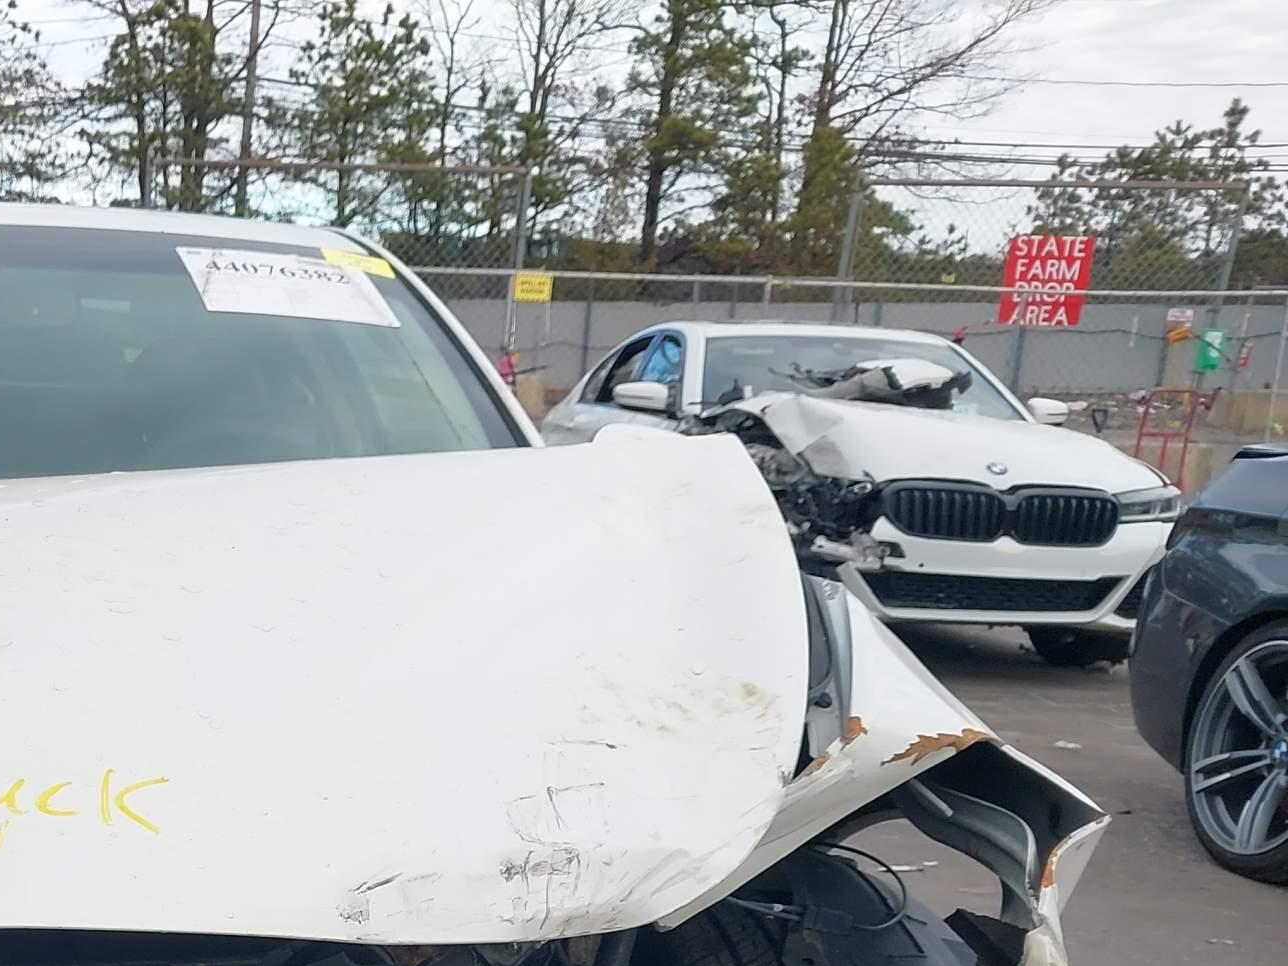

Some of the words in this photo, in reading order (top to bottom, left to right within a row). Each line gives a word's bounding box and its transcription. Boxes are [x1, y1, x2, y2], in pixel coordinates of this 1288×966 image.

[1015, 235, 1089, 256] STATE
[205, 260, 351, 285] 44076382
[1014, 259, 1081, 280] FARM
[1012, 281, 1075, 303] DROP
[1007, 305, 1069, 326] AREA
